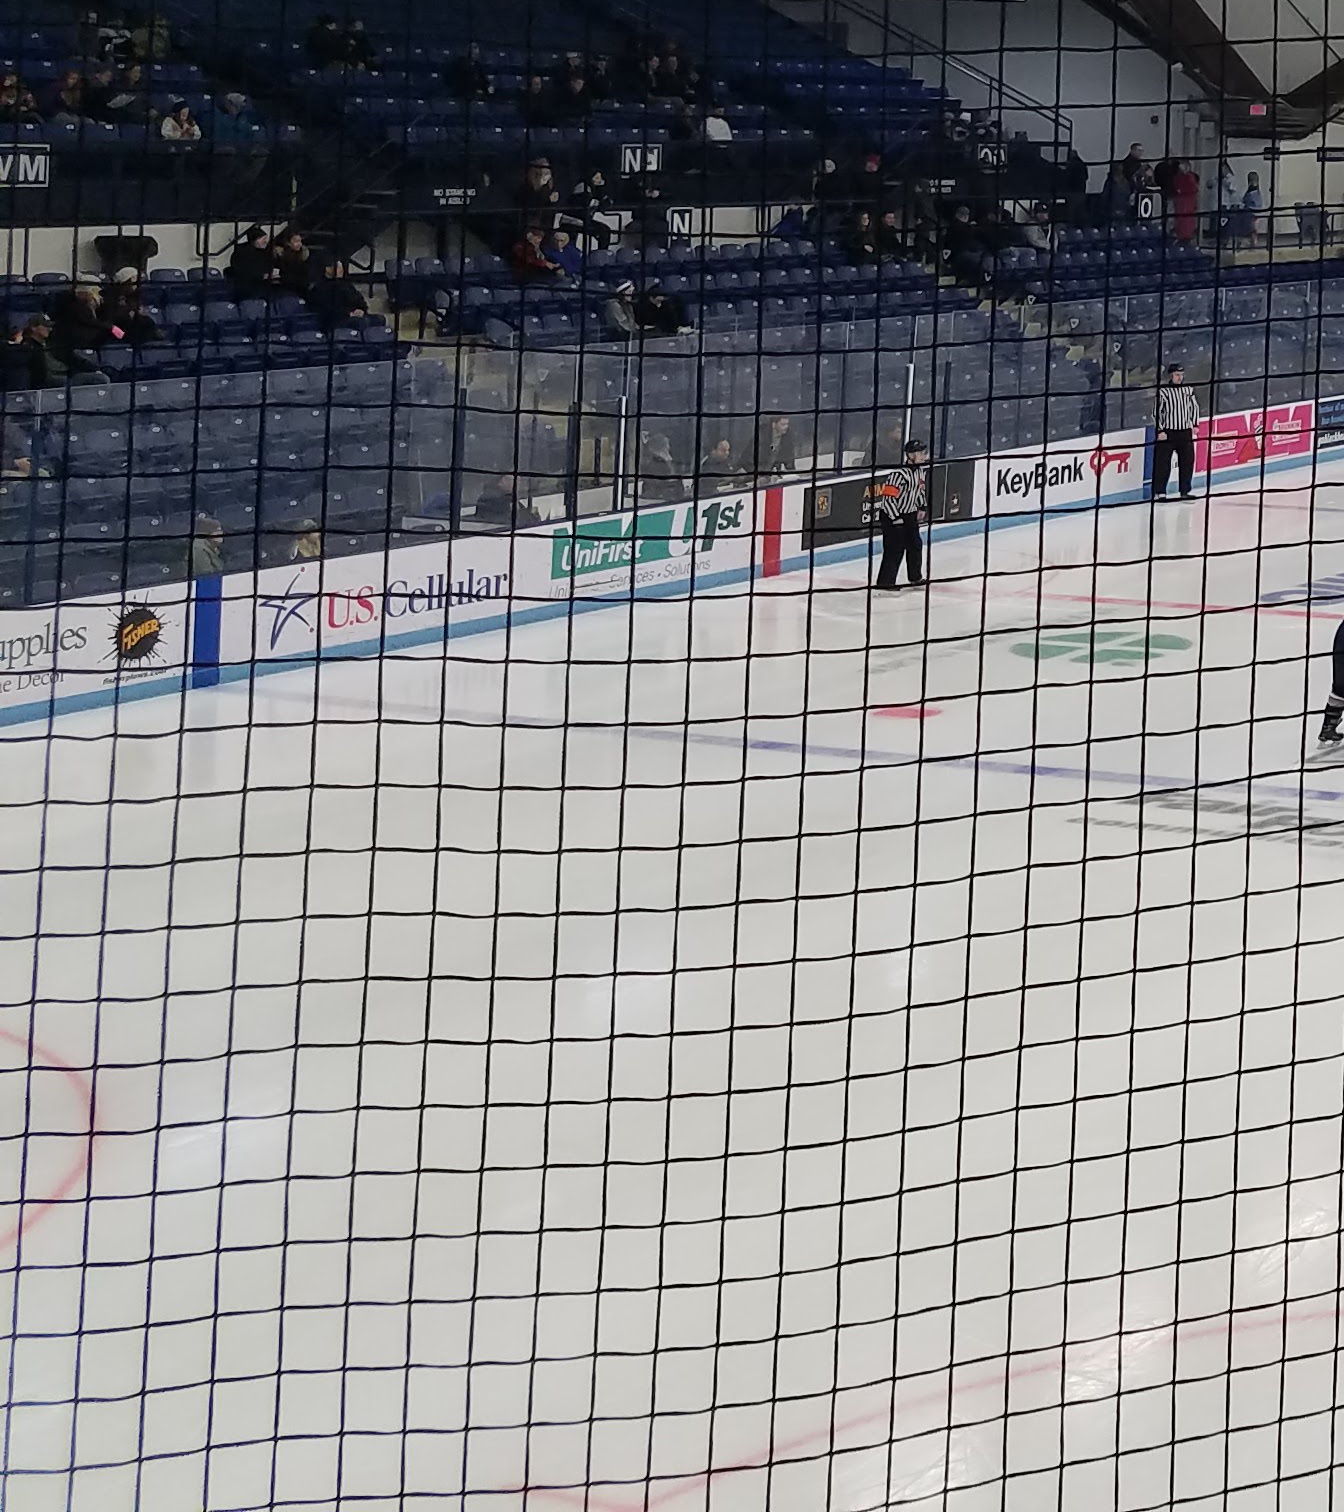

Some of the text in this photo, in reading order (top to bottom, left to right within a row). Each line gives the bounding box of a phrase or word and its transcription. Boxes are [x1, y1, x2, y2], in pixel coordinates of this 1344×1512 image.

[672, 211, 691, 234] N
[995, 455, 1085, 498] KeyBank
[561, 538, 645, 572] UniFirst
[610, 567, 655, 588] Serces
[659, 558, 712, 579] Solutons
[326, 585, 379, 629] U.S.
[385, 568, 508, 618] Cellular
[0, 621, 87, 670] pples
[122, 618, 160, 653] FISHER
